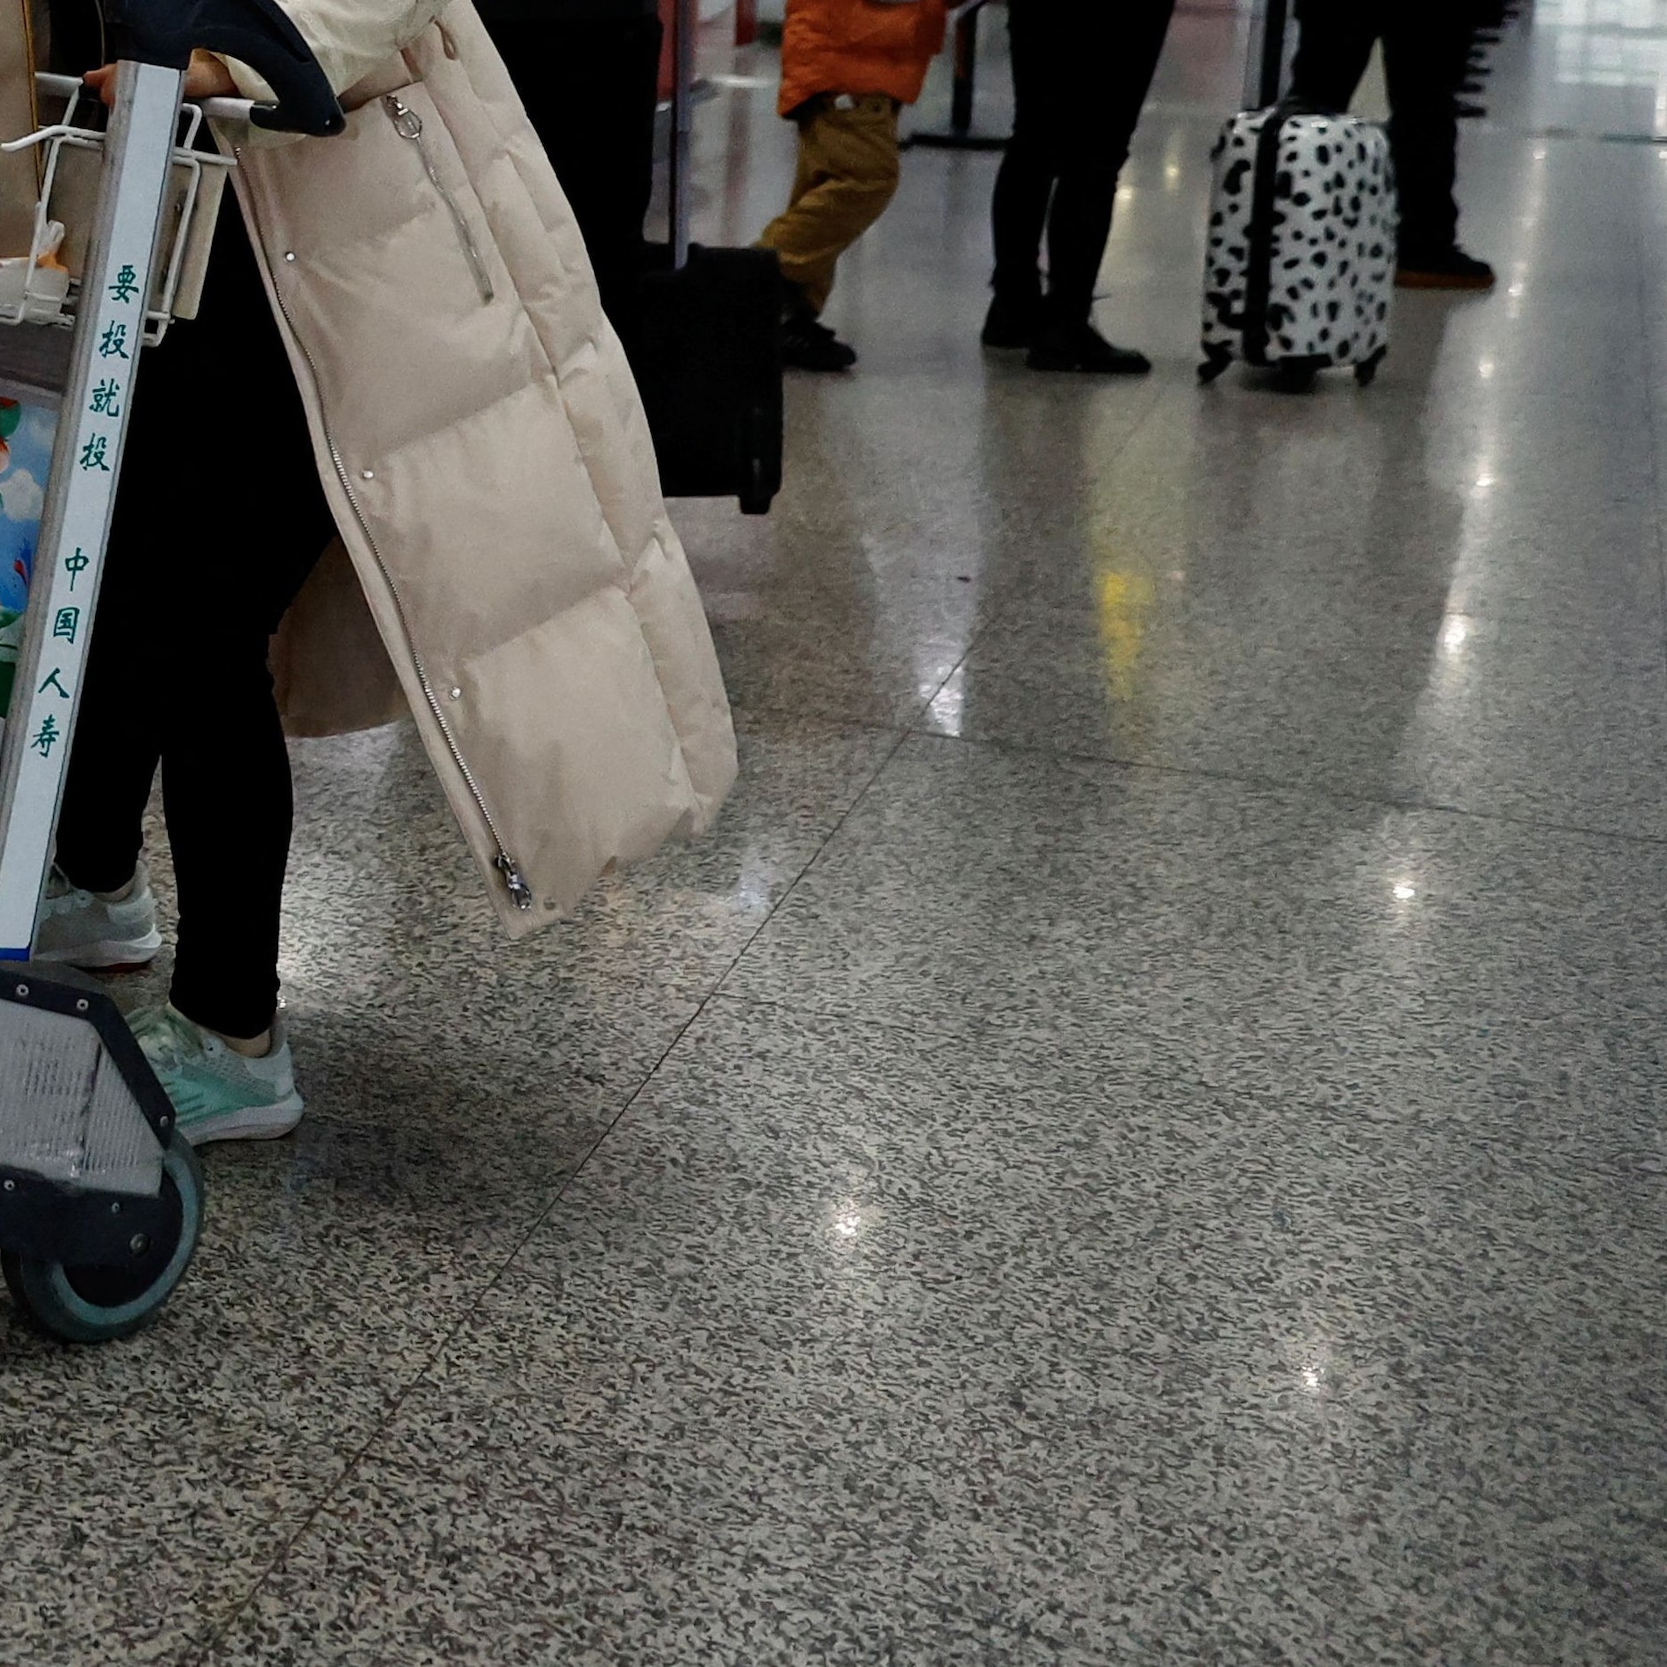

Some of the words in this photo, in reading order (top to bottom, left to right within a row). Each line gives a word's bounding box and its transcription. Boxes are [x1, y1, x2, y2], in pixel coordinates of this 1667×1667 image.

[80, 264, 140, 472] 要投就投
[31, 547, 90, 758] 中国人寿
